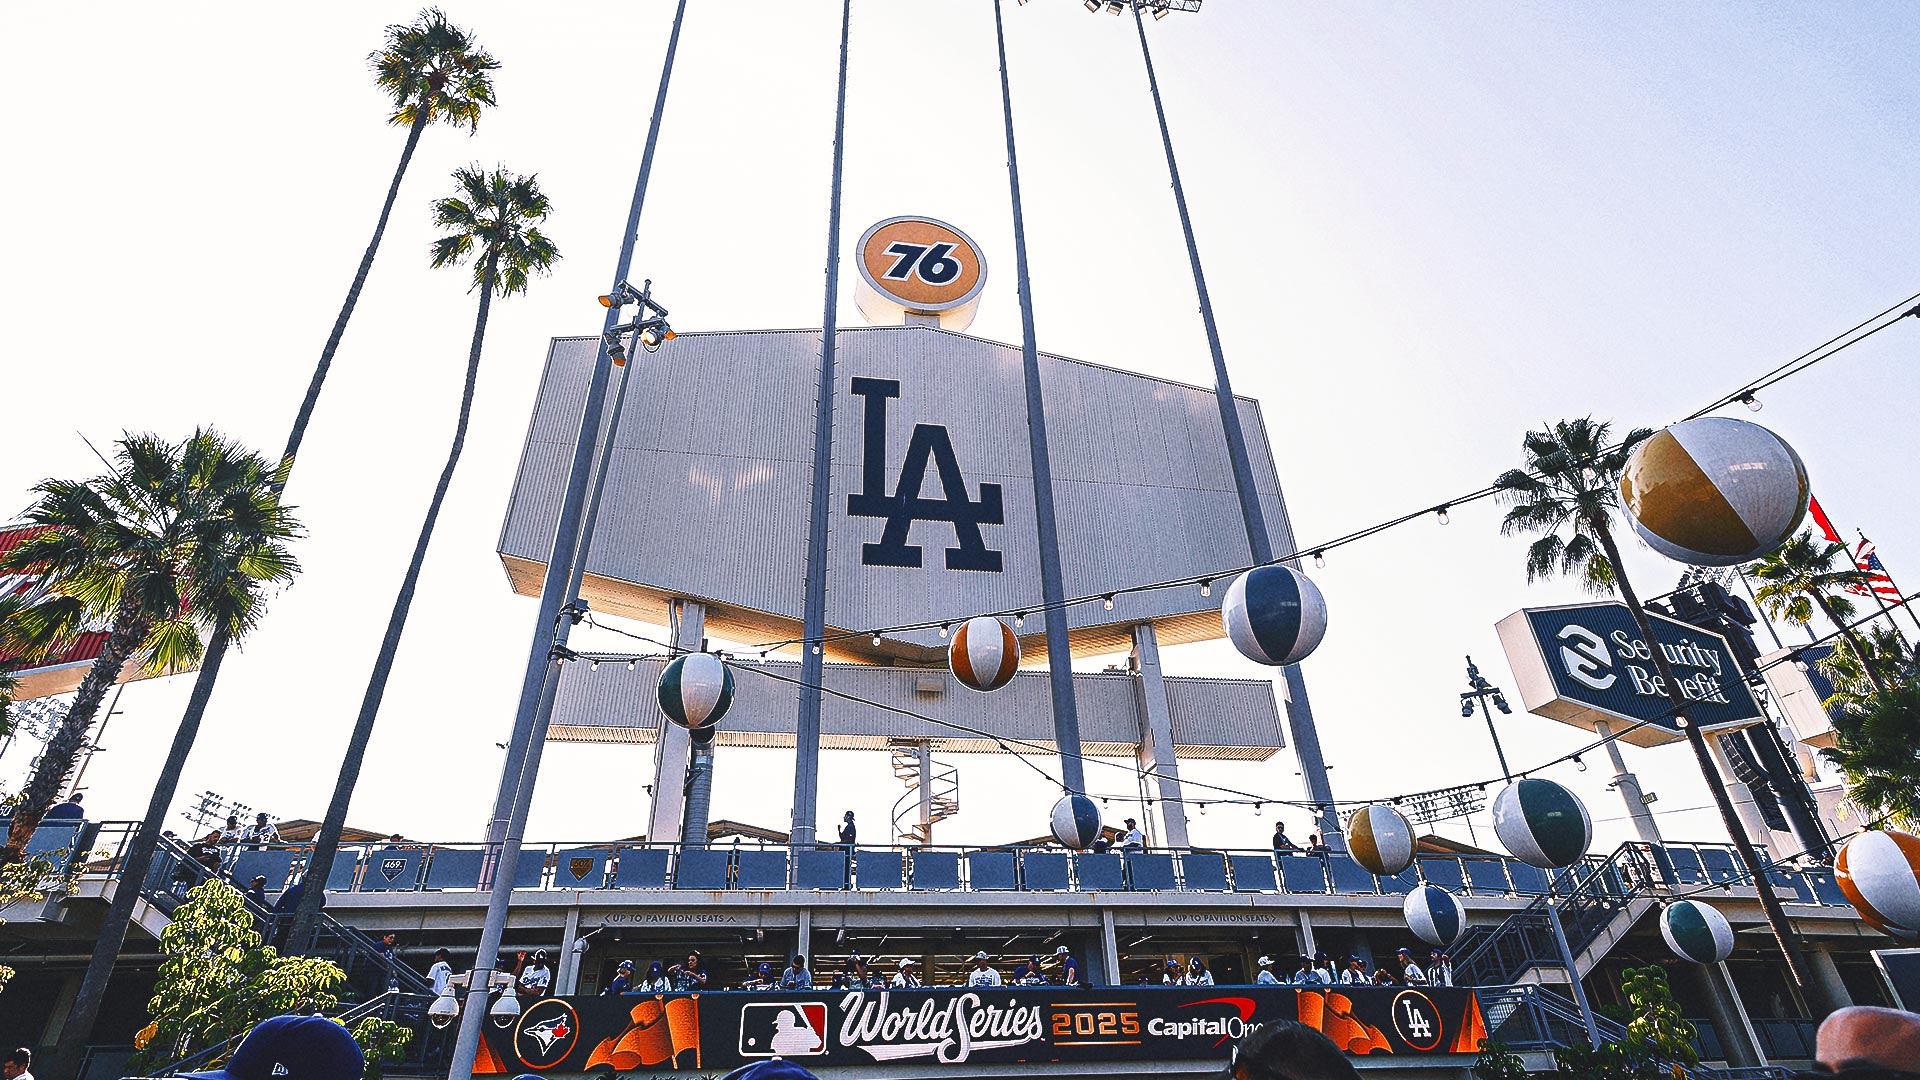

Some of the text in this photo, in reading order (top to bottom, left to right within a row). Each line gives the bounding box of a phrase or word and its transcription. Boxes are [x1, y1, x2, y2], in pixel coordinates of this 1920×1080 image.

[881, 241, 963, 286] 76
[847, 376, 1004, 574] LA
[1610, 630, 1722, 676] Seurity
[613, 914, 724, 923] UP TO PAVILION SEATS
[1175, 914, 1270, 922] UP TO PAVILION SEATS
[839, 991, 1043, 1063] World Series
[1051, 1012, 1141, 1036] 2025
[1402, 999, 1432, 1038] LA
